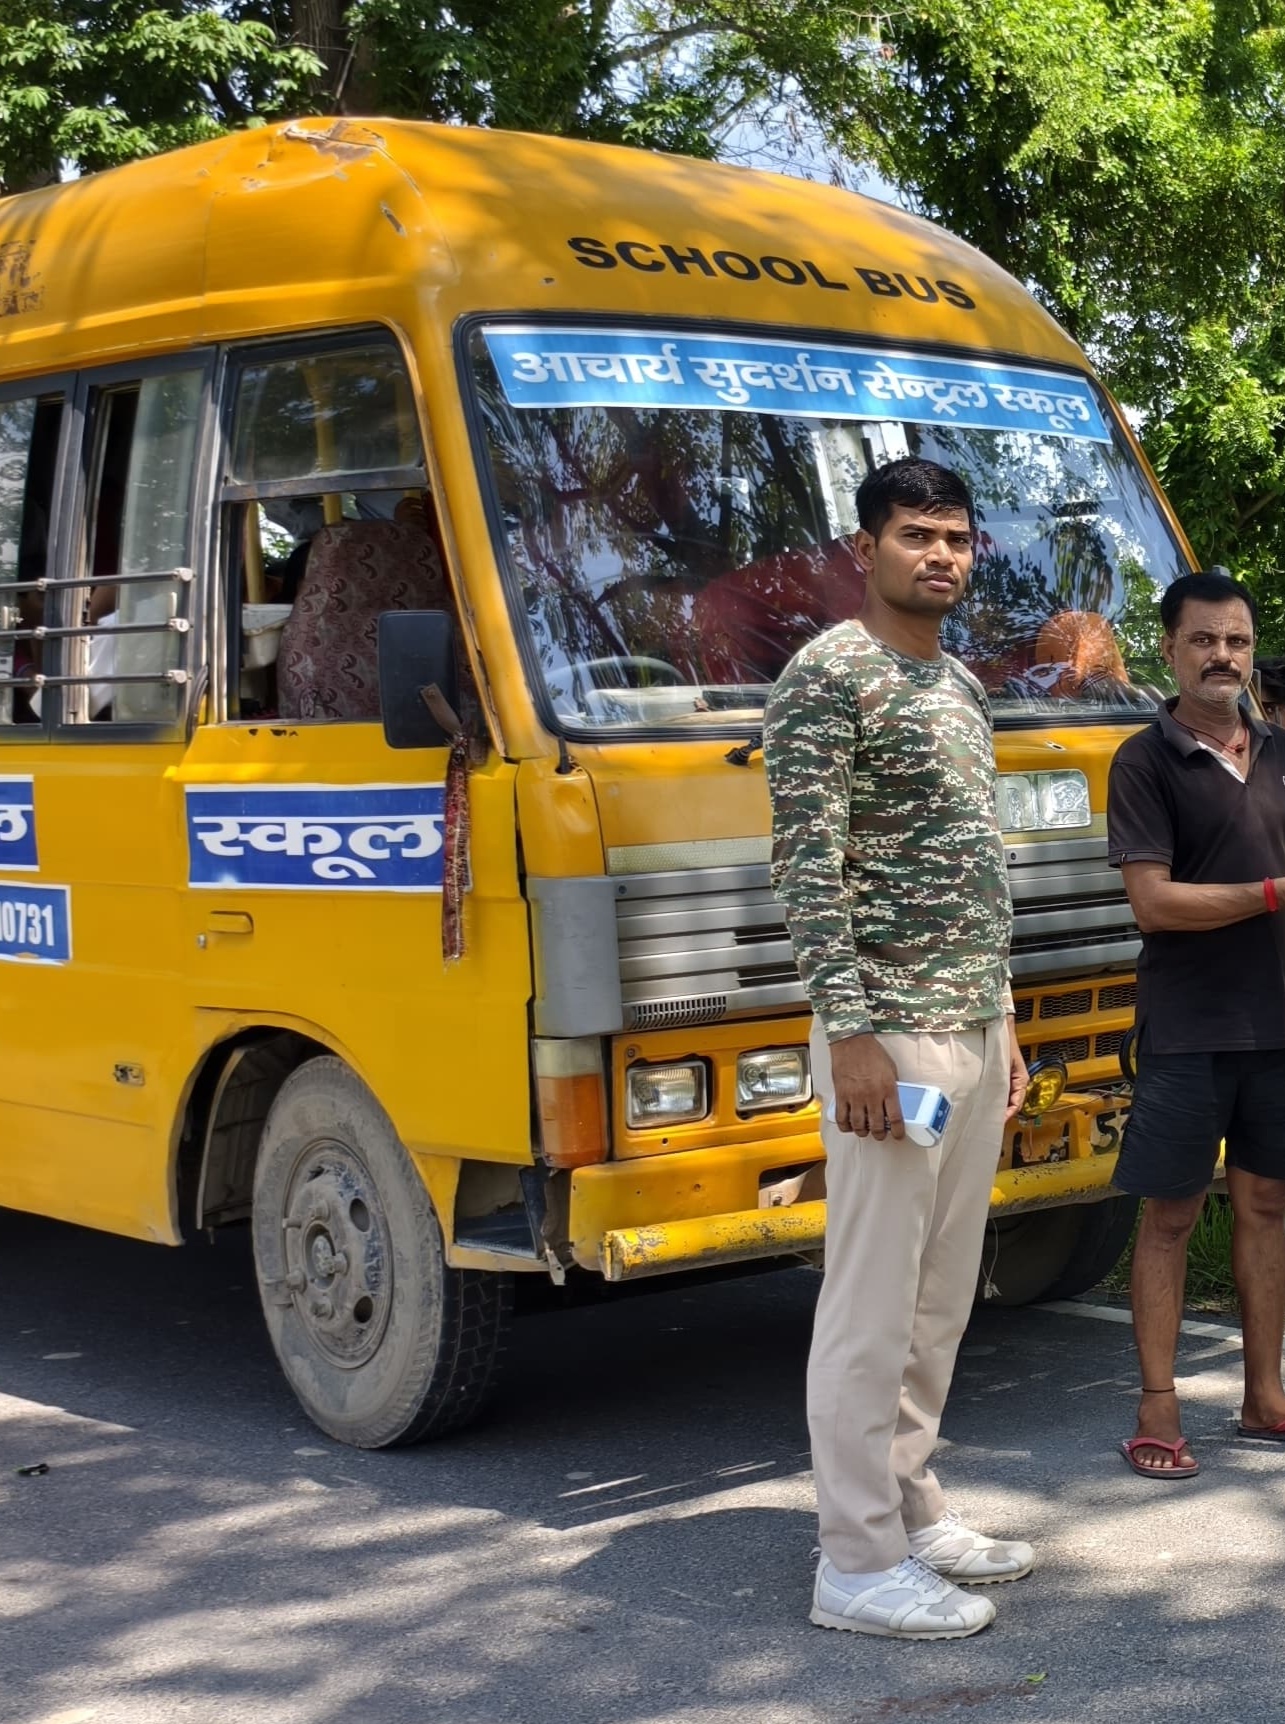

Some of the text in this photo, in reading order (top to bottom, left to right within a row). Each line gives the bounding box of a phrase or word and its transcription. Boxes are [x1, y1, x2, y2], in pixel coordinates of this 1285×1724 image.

[568, 237, 976, 310] SCHOOL BUS
[511, 344, 1090, 430] आचार्य सुदर्शन सेन्ट्रल स्कूल
[193, 814, 445, 880] स्कूल
[0, 901, 54, 946] 0731
[1091, 1109, 1130, 1155] 5
